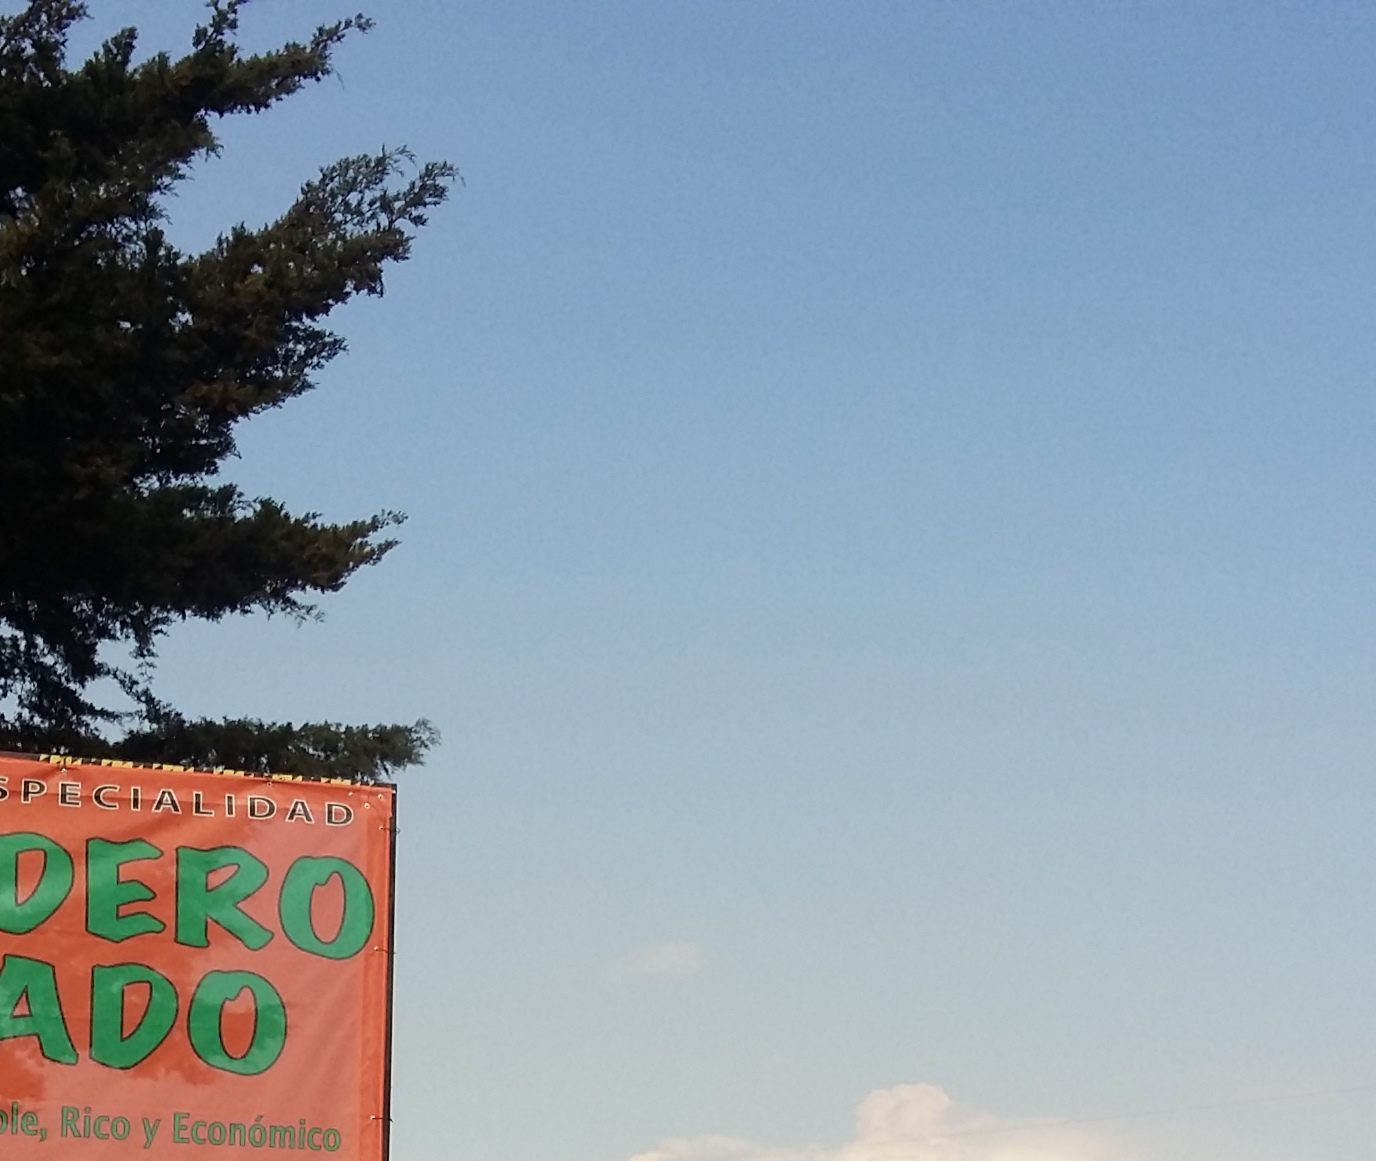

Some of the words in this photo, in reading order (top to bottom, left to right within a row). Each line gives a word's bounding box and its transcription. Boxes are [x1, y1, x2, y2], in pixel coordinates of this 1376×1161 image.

[61, 1106, 130, 1140] Rico
[142, 1118, 160, 1148] y
[173, 1112, 341, 1151] Económico
